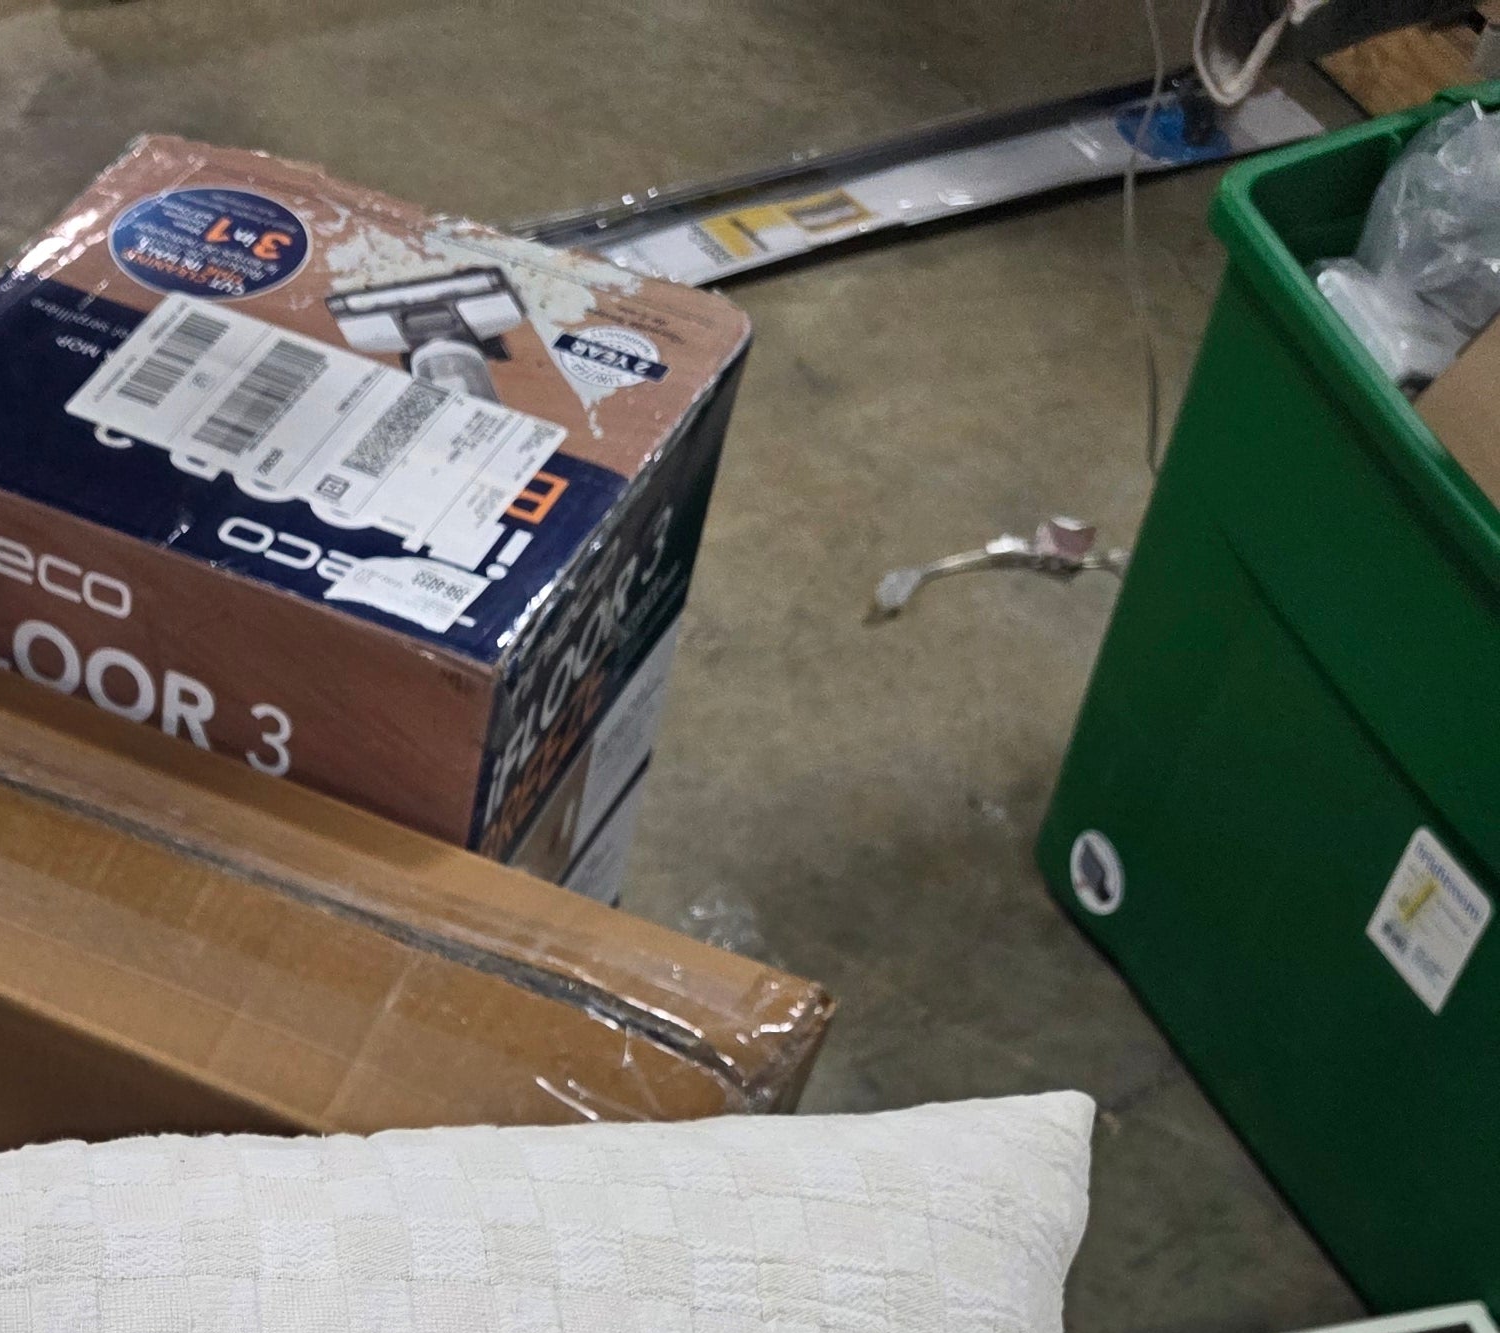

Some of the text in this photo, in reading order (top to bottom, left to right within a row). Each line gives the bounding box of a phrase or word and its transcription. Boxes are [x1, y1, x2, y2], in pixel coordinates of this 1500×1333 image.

[204, 216, 233, 243] 1
[252, 231, 292, 260] 3
[55, 335, 100, 358] MOP
[570, 340, 651, 374] 2 YEAR
[640, 505, 674, 584] 3
[245, 703, 293, 777] 3
